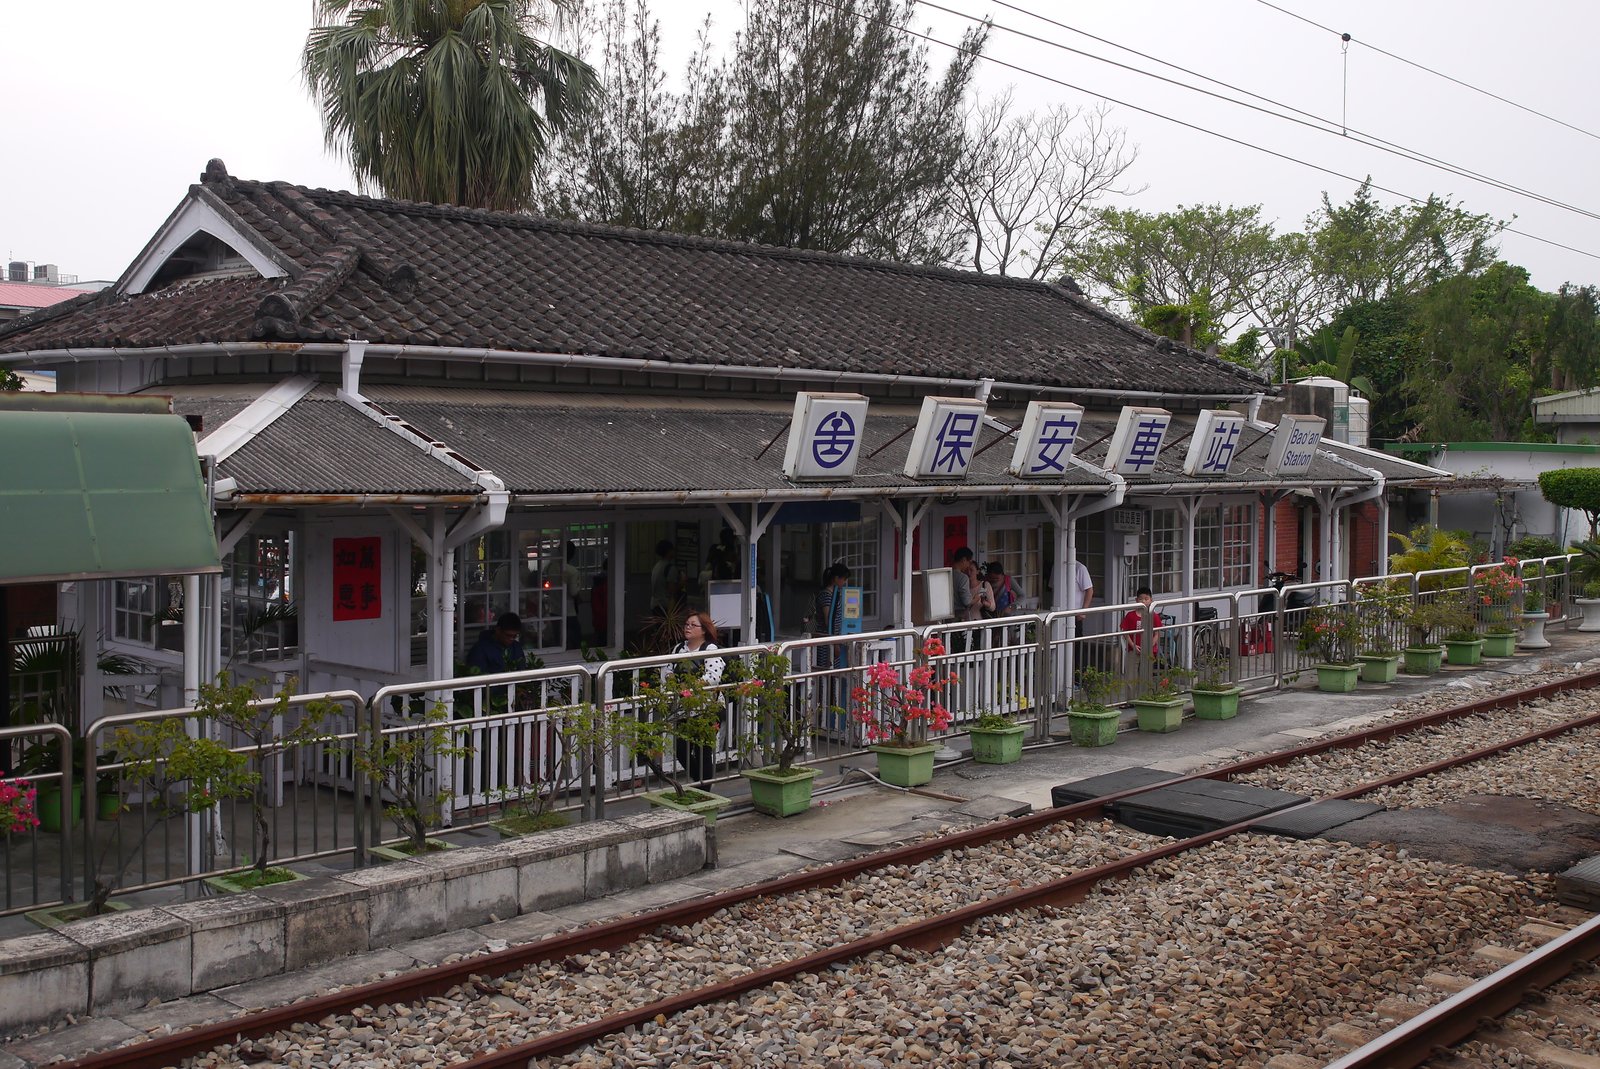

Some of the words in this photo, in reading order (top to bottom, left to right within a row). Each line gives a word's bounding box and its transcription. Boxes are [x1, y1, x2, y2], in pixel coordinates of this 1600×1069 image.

[930, 412, 1240, 473] 保安車站
[1290, 429, 1320, 445] Bao'an
[1284, 450, 1312, 466] Station
